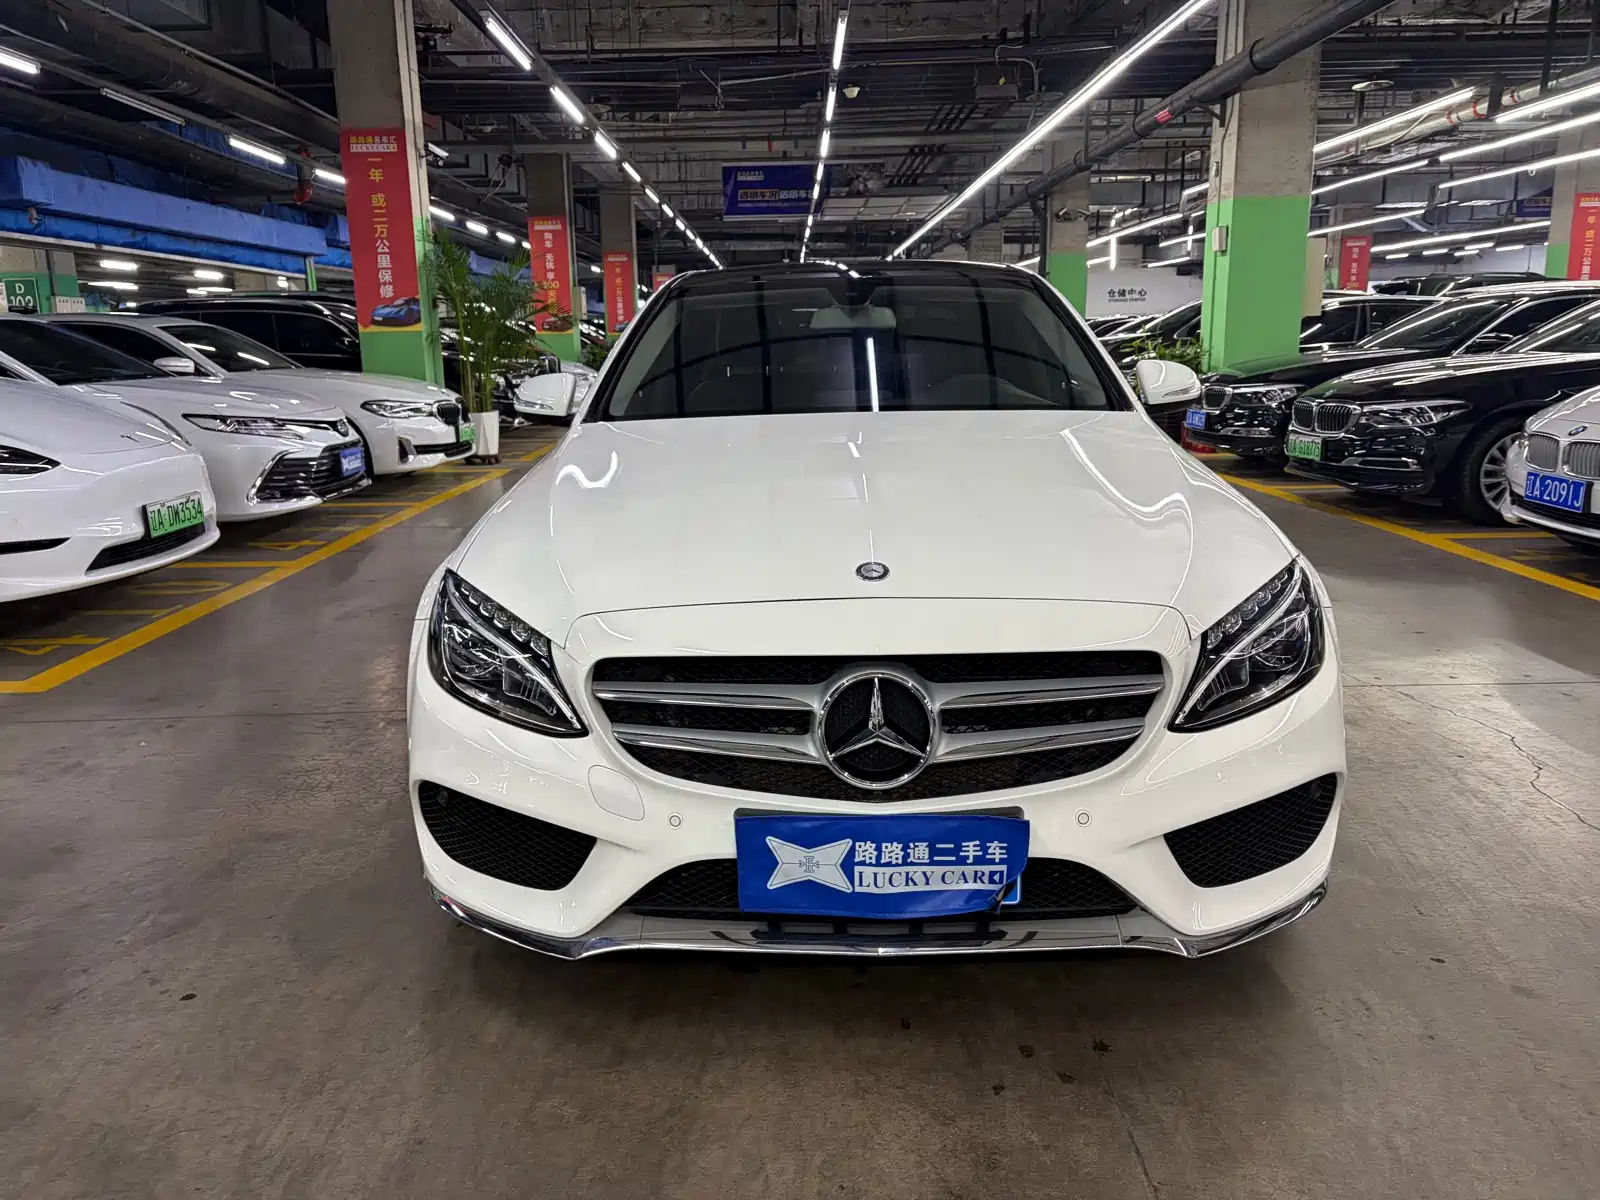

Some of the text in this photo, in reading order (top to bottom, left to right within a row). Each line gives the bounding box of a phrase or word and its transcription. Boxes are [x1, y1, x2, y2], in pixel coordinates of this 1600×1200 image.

[15, 283, 25, 294] D
[854, 840, 1008, 865] 路路通二手车
[857, 870, 987, 889] LUCKY CAR
